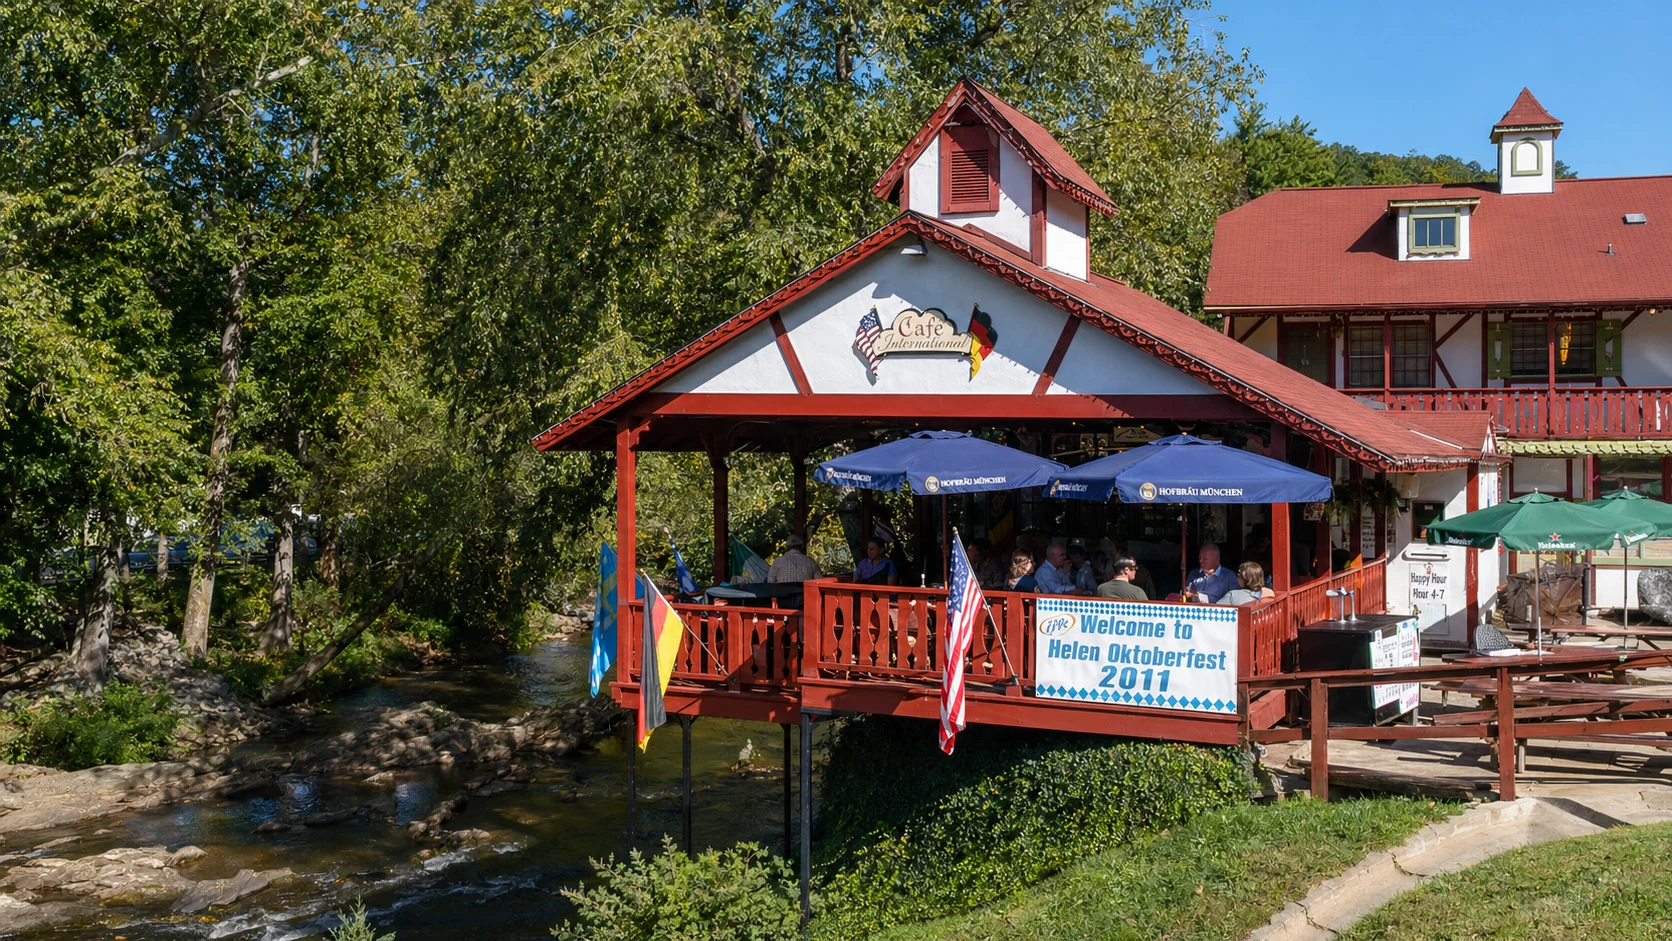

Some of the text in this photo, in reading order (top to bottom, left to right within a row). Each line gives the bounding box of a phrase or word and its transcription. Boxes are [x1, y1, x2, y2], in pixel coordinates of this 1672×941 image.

[877, 333, 968, 351] International
[1410, 572, 1431, 586] Happy
[1431, 589, 1445, 600] 4-7
[1080, 614, 1166, 638] Welcome
[1174, 619, 1193, 640] to
[1047, 639, 1227, 670] Helen Oktoberfest
[1098, 665, 1170, 692] 2011
